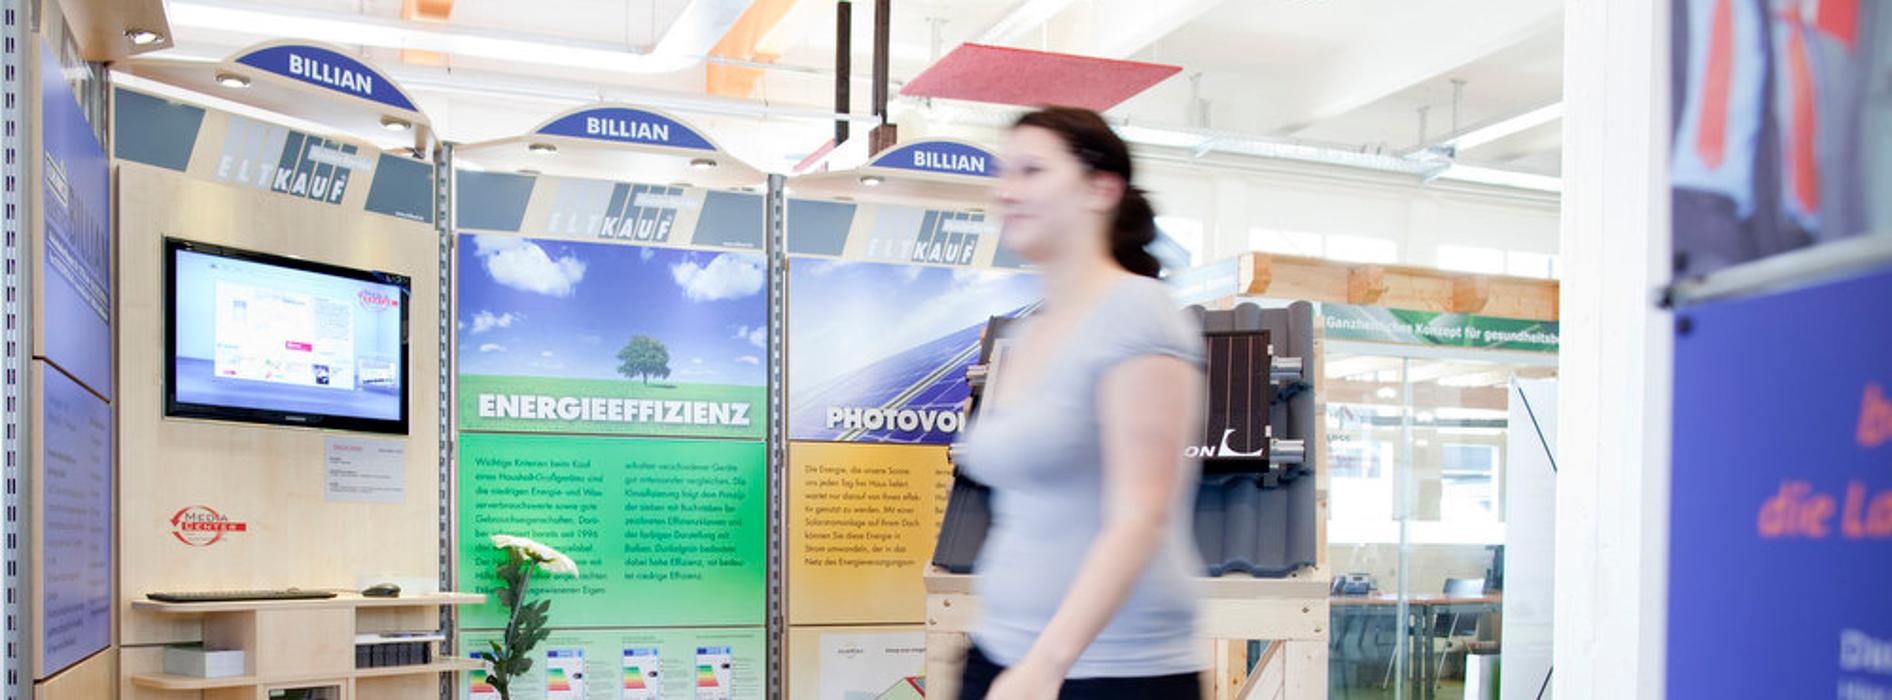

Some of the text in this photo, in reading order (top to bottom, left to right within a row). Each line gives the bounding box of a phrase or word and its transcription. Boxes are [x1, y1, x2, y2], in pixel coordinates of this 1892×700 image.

[289, 53, 372, 95] BILLIAN
[587, 117, 669, 142] BILLIAN
[914, 150, 985, 173] BILLIAN
[1415, 323, 1462, 338] Konzept
[1464, 327, 1481, 339] für
[479, 393, 750, 425] ENERGIEEFFIZIENZ
[1856, 381, 1892, 446] b
[185, 512, 228, 521] MEDIA
[1757, 481, 1836, 537] die
[184, 522, 238, 531] CENTER
